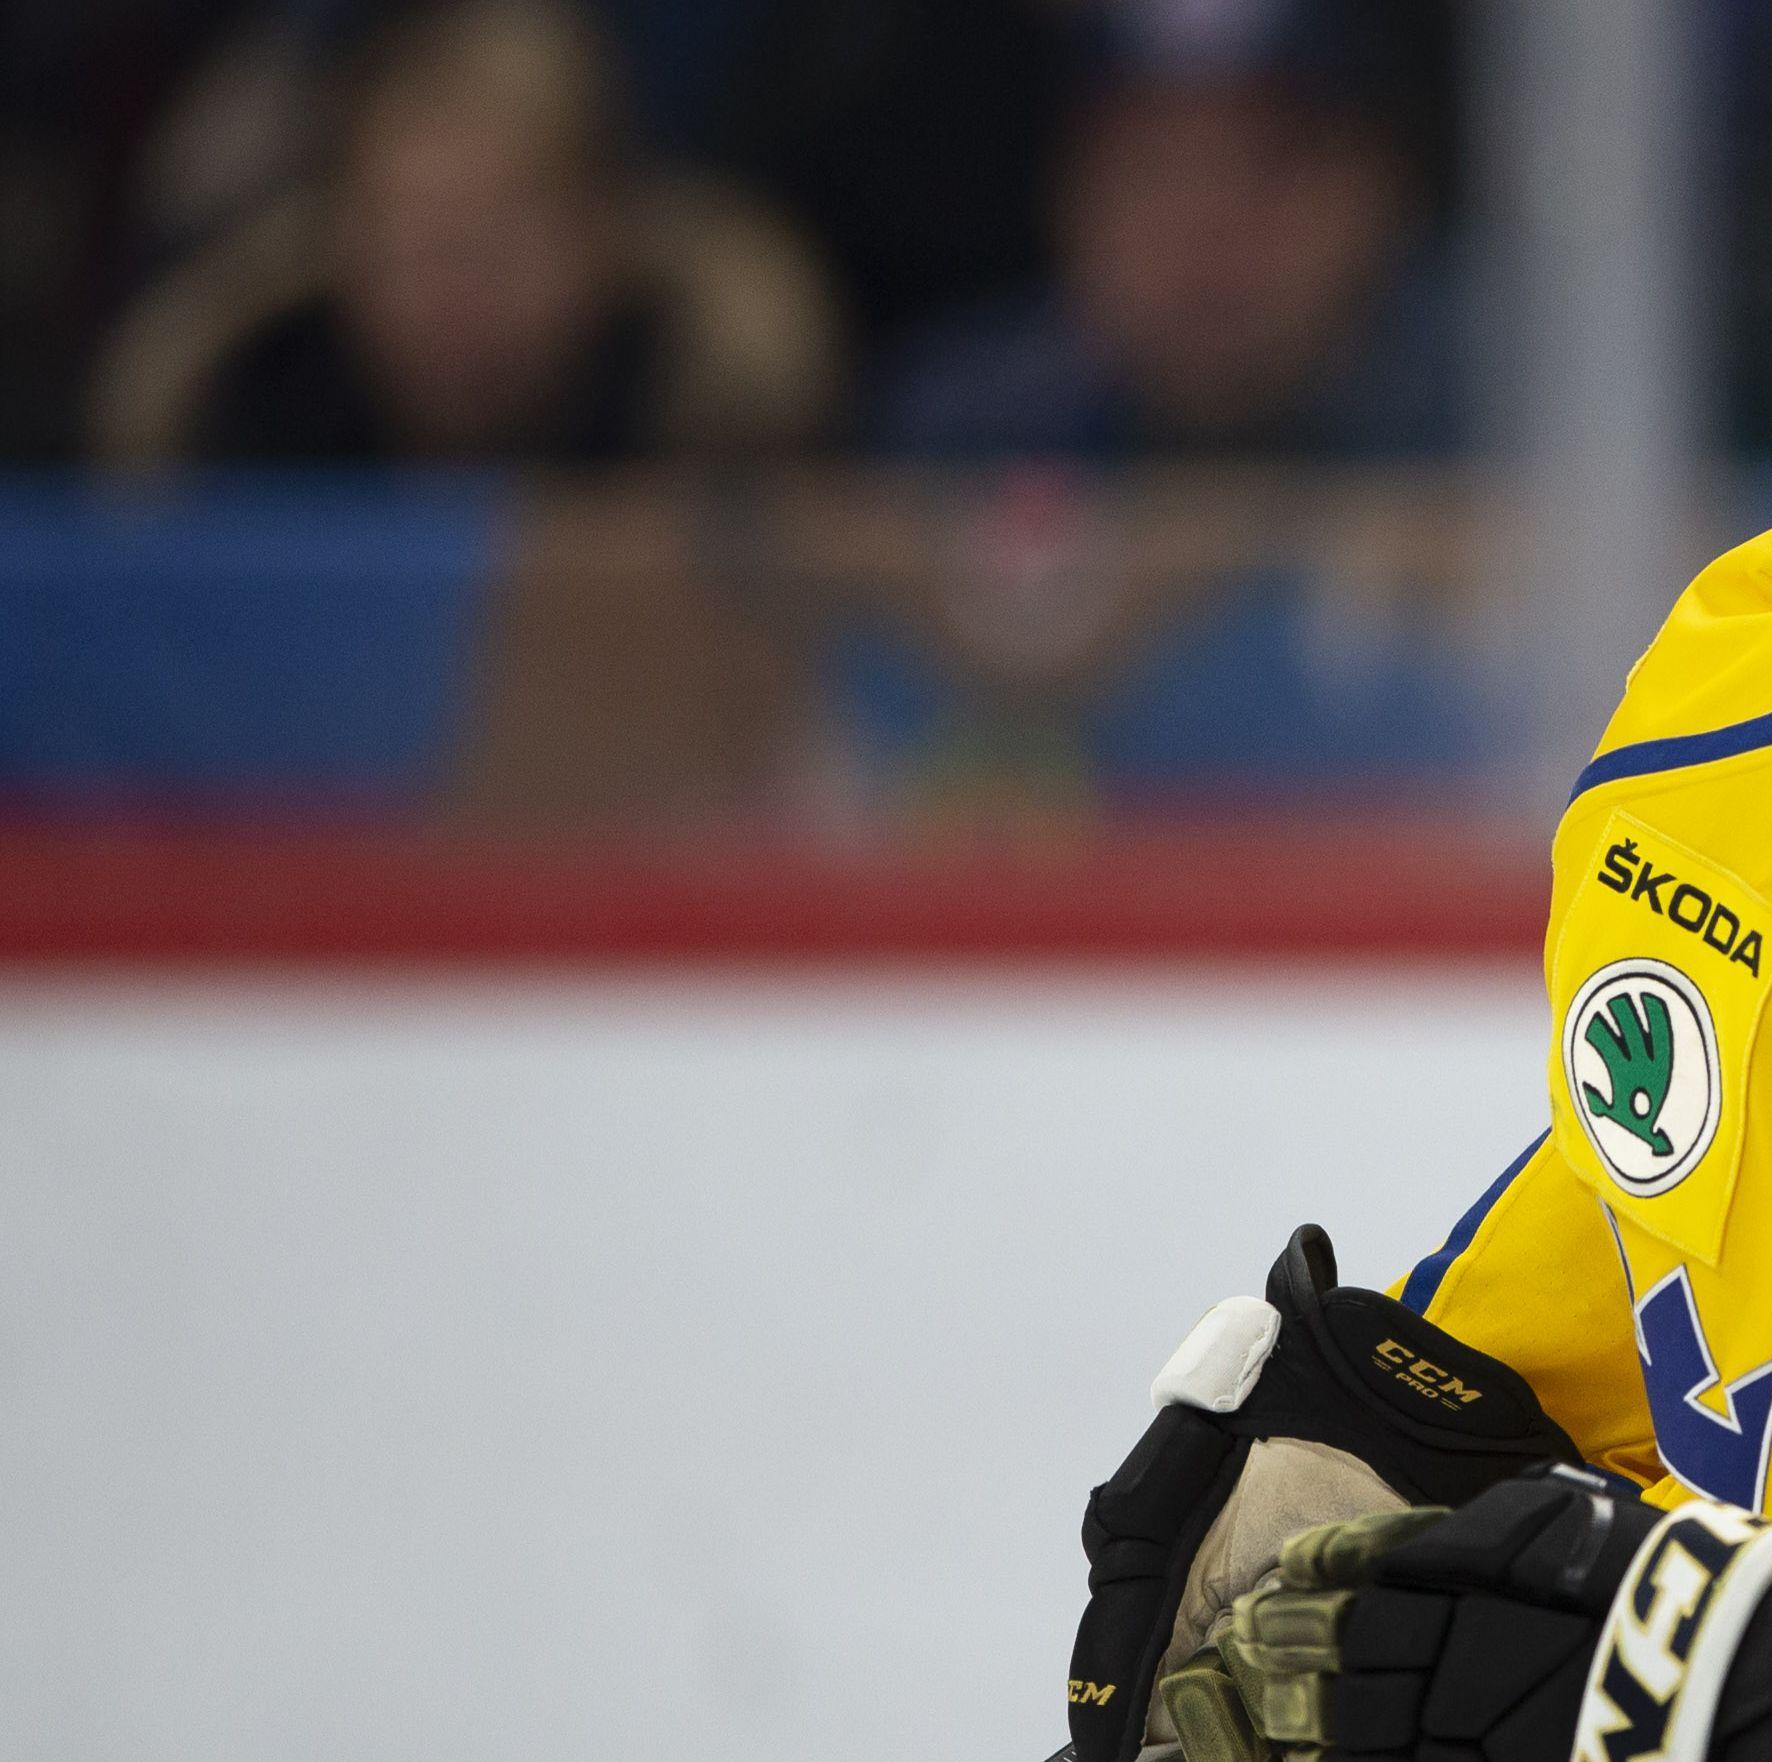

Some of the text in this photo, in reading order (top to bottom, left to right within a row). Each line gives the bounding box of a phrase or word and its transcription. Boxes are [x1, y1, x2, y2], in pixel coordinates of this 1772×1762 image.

[1597, 837, 1763, 979] ŠKODA
[1376, 1338, 1482, 1403] CCM
[1395, 1372, 1439, 1399] PRO
